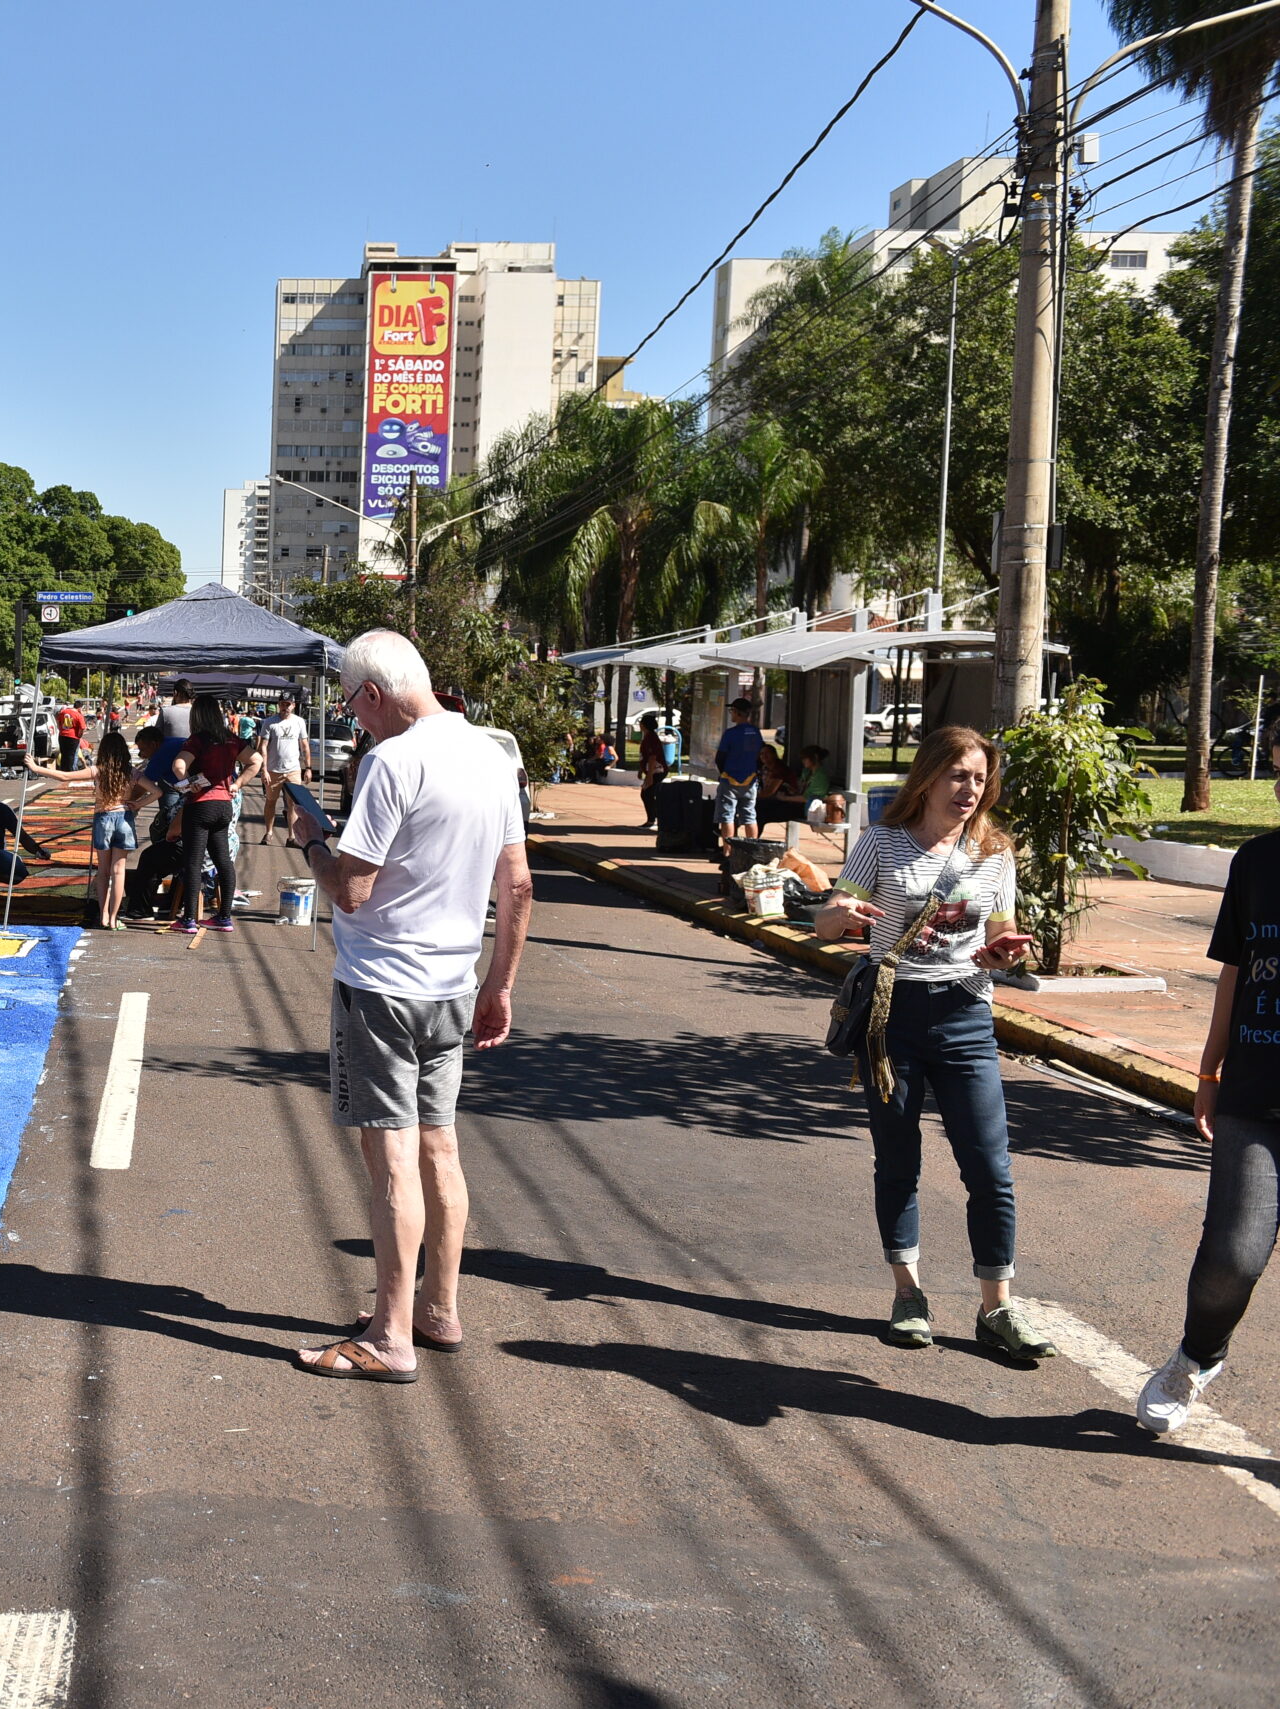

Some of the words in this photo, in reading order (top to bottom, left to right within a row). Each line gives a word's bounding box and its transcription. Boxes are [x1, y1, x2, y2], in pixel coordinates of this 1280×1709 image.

[378, 304, 418, 327] DIA
[416, 296, 446, 346] F
[383, 330, 414, 342] Fort
[387, 356, 445, 372] SÁBADO
[373, 373, 392, 383] DO
[392, 371, 415, 383] MÊS
[416, 371, 423, 383] É
[424, 373, 444, 383] DIA
[373, 384, 389, 394] DE
[390, 384, 443, 394] COMPRA
[372, 393, 444, 415] FORT!
[371, 475, 440, 485] EXCLUSVOS
[377, 484, 394, 496] SÓ
[1256, 990, 1267, 1014] É
